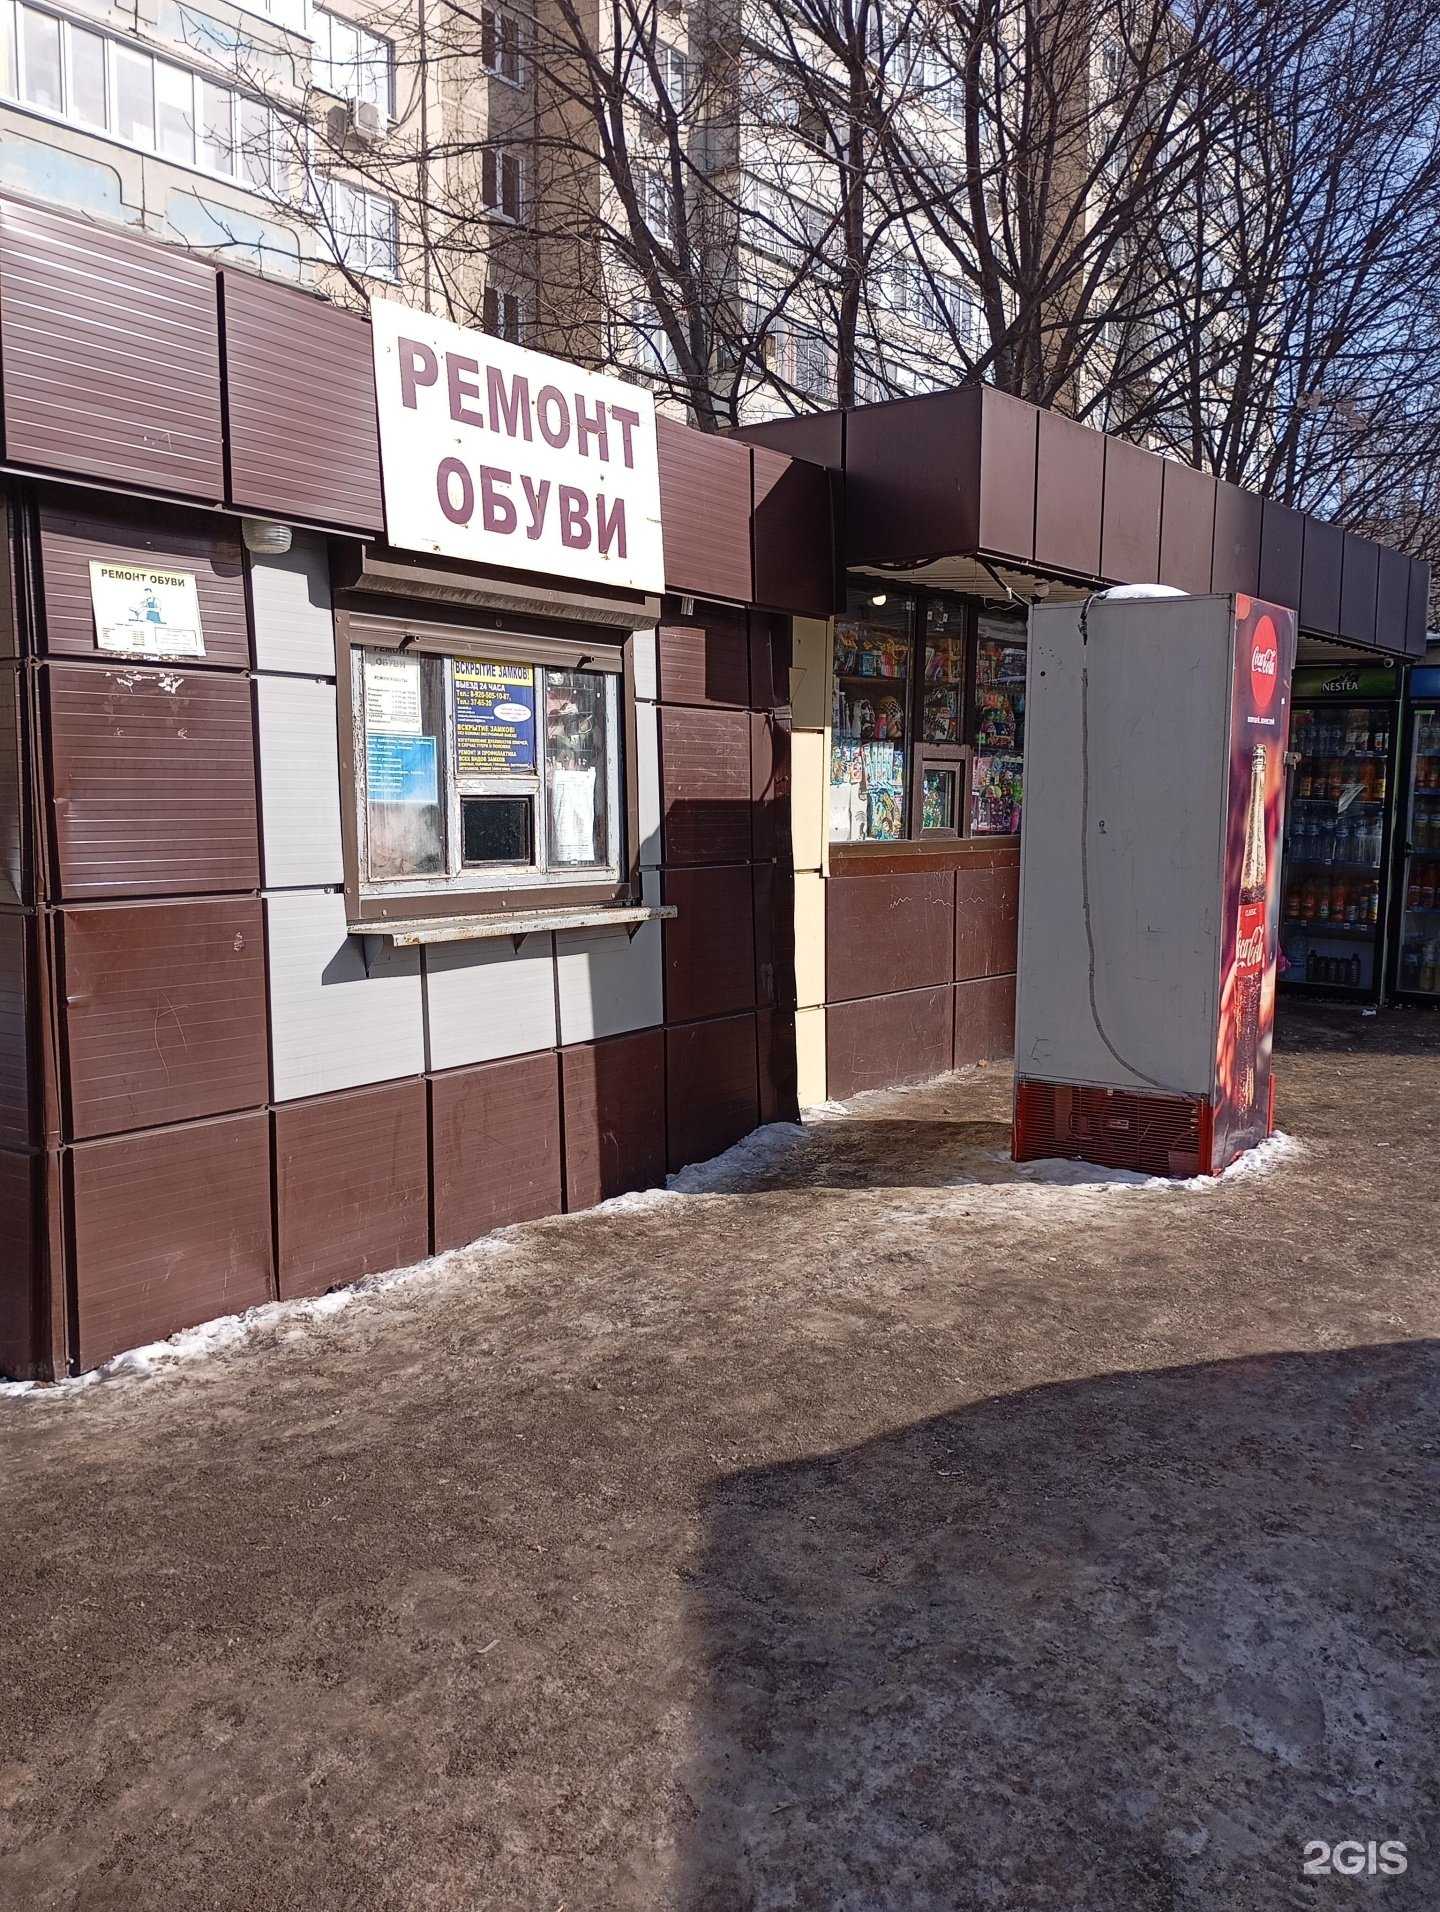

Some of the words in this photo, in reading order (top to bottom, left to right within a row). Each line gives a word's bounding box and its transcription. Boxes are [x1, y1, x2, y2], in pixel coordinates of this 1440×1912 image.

[398, 336, 640, 469] РЕМОНТ
[436, 457, 628, 559] ОБУВИ
[101, 568, 147, 582] РЕМОНТ
[150, 575, 185, 587] ОБУВИ
[455, 660, 496, 677] ВСКРЫТИЕ
[498, 665, 530, 680] ЗАМКОВ!
[455, 680, 479, 690] ВЫЕЗД
[479, 682, 488, 690] 24
[488, 683, 506, 692] ЧАСА
[1322, 681, 1359, 692] NESTEA
